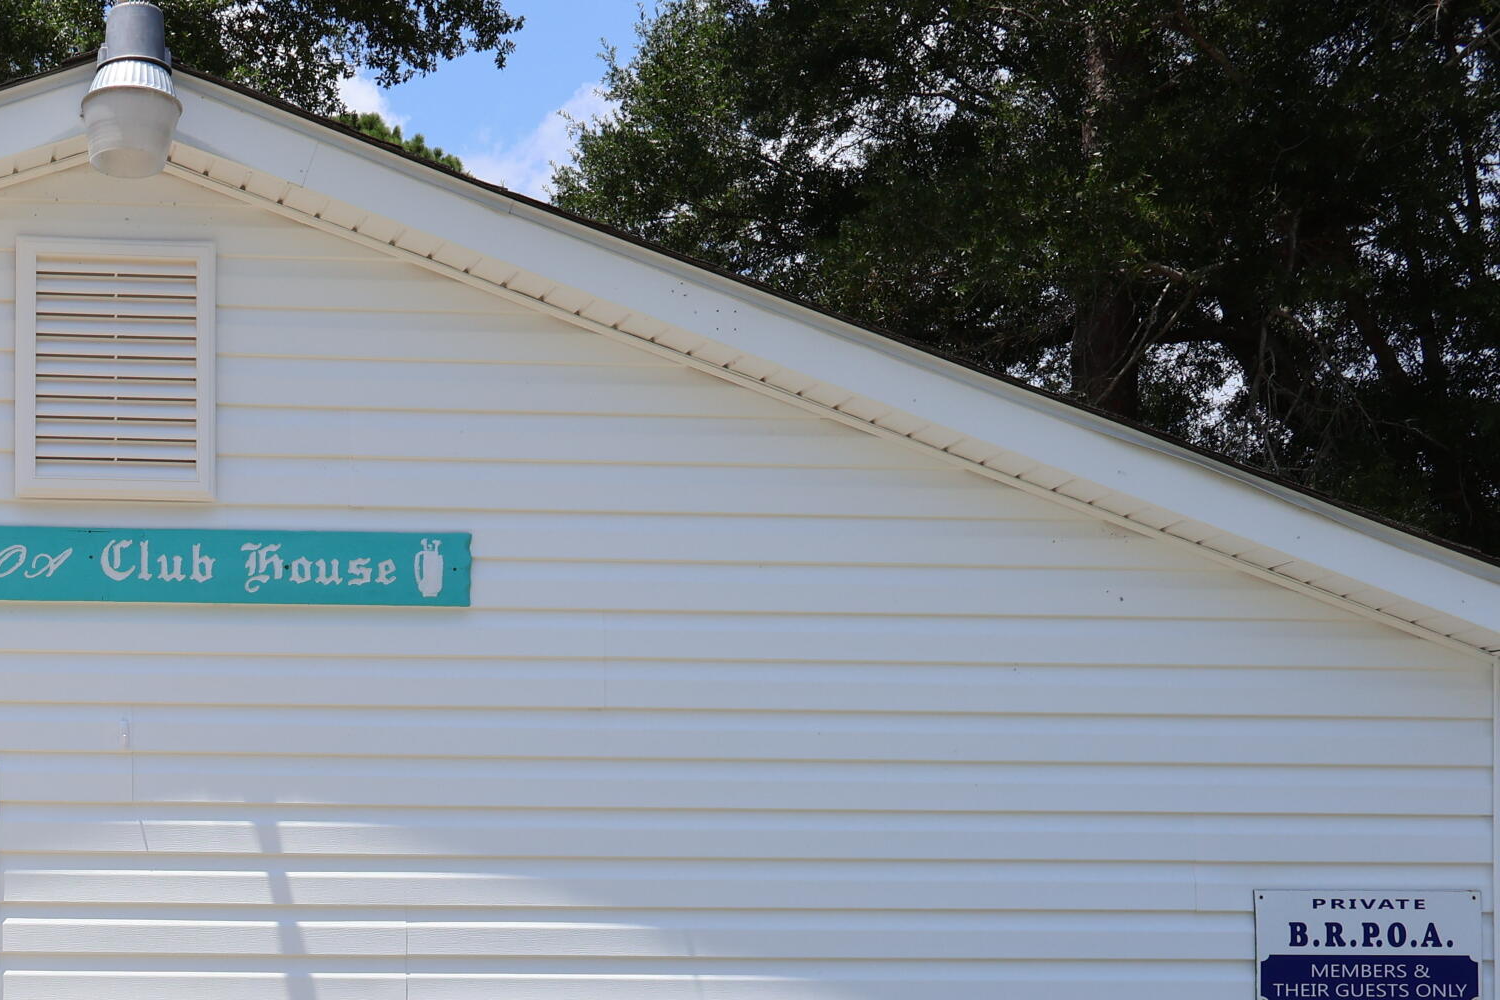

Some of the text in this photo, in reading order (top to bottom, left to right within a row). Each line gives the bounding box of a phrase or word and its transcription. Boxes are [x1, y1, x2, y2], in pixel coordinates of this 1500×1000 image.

[100, 539, 216, 583] Club
[240, 542, 397, 593] House
[1312, 898, 1426, 910] PRIVATE
[1288, 921, 1454, 948] B.R.P.O.A.
[1311, 963, 1431, 978] MEMBERS &
[1273, 982, 1468, 998] THEIR GUESTS ONLY
